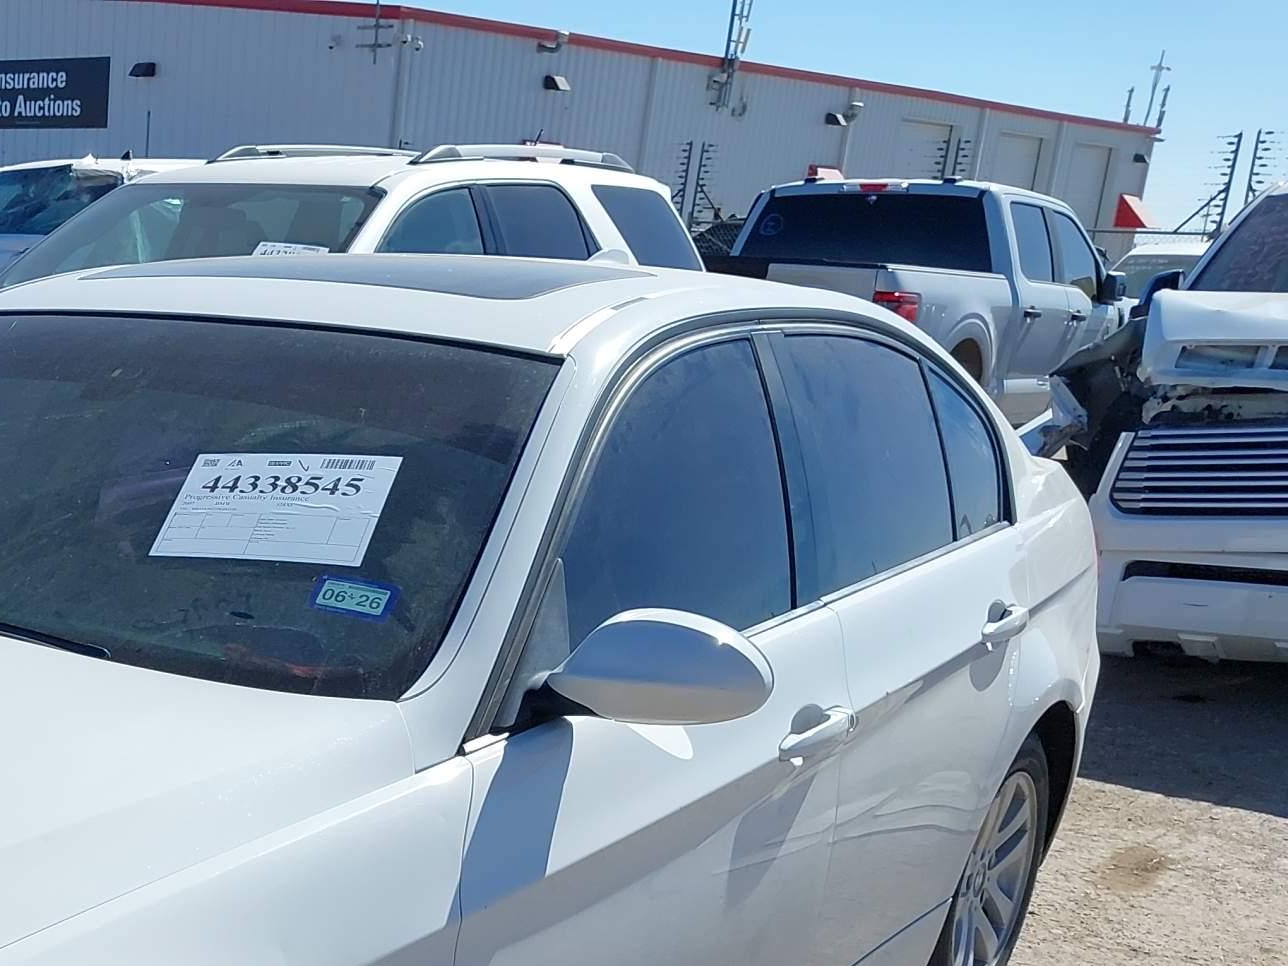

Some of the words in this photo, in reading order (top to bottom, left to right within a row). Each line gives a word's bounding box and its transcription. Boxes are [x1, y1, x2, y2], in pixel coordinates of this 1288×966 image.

[14, 94, 81, 117] Auctions
[201, 475, 364, 496] 44338545
[322, 588, 348, 603] 06
[355, 594, 383, 609] 26
